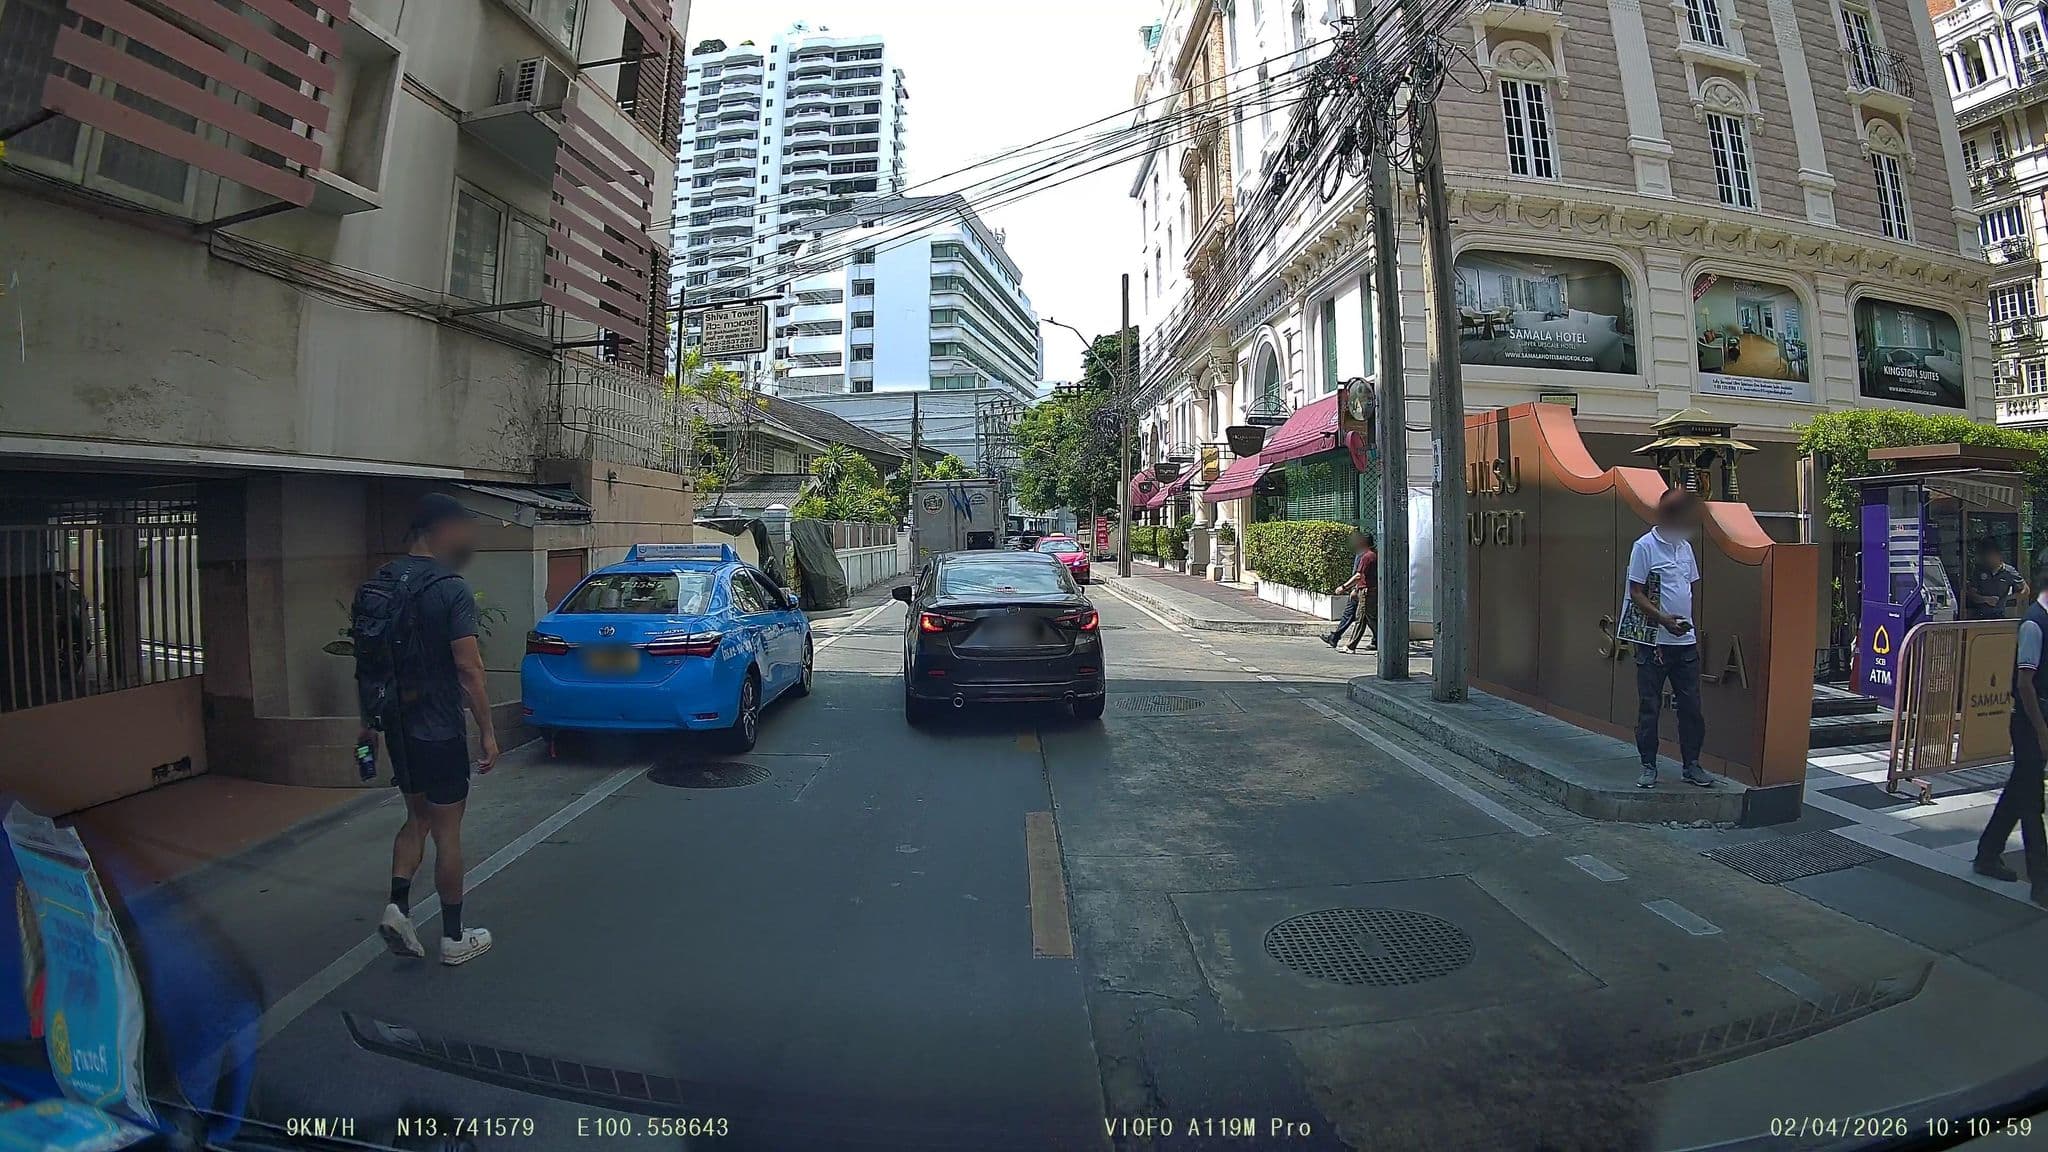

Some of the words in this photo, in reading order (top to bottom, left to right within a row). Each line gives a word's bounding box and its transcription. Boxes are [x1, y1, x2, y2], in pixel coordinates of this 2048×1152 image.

[705, 313, 729, 321] Shiva
[732, 310, 759, 318] Tower
[1509, 328, 1553, 341] SAMALA
[1556, 331, 1587, 344] HOTEL
[1883, 365, 1918, 378] KINGSTON
[1919, 369, 1940, 381] SUITES
[1875, 657, 1887, 667] SCB
[1869, 668, 1892, 685] ATM
